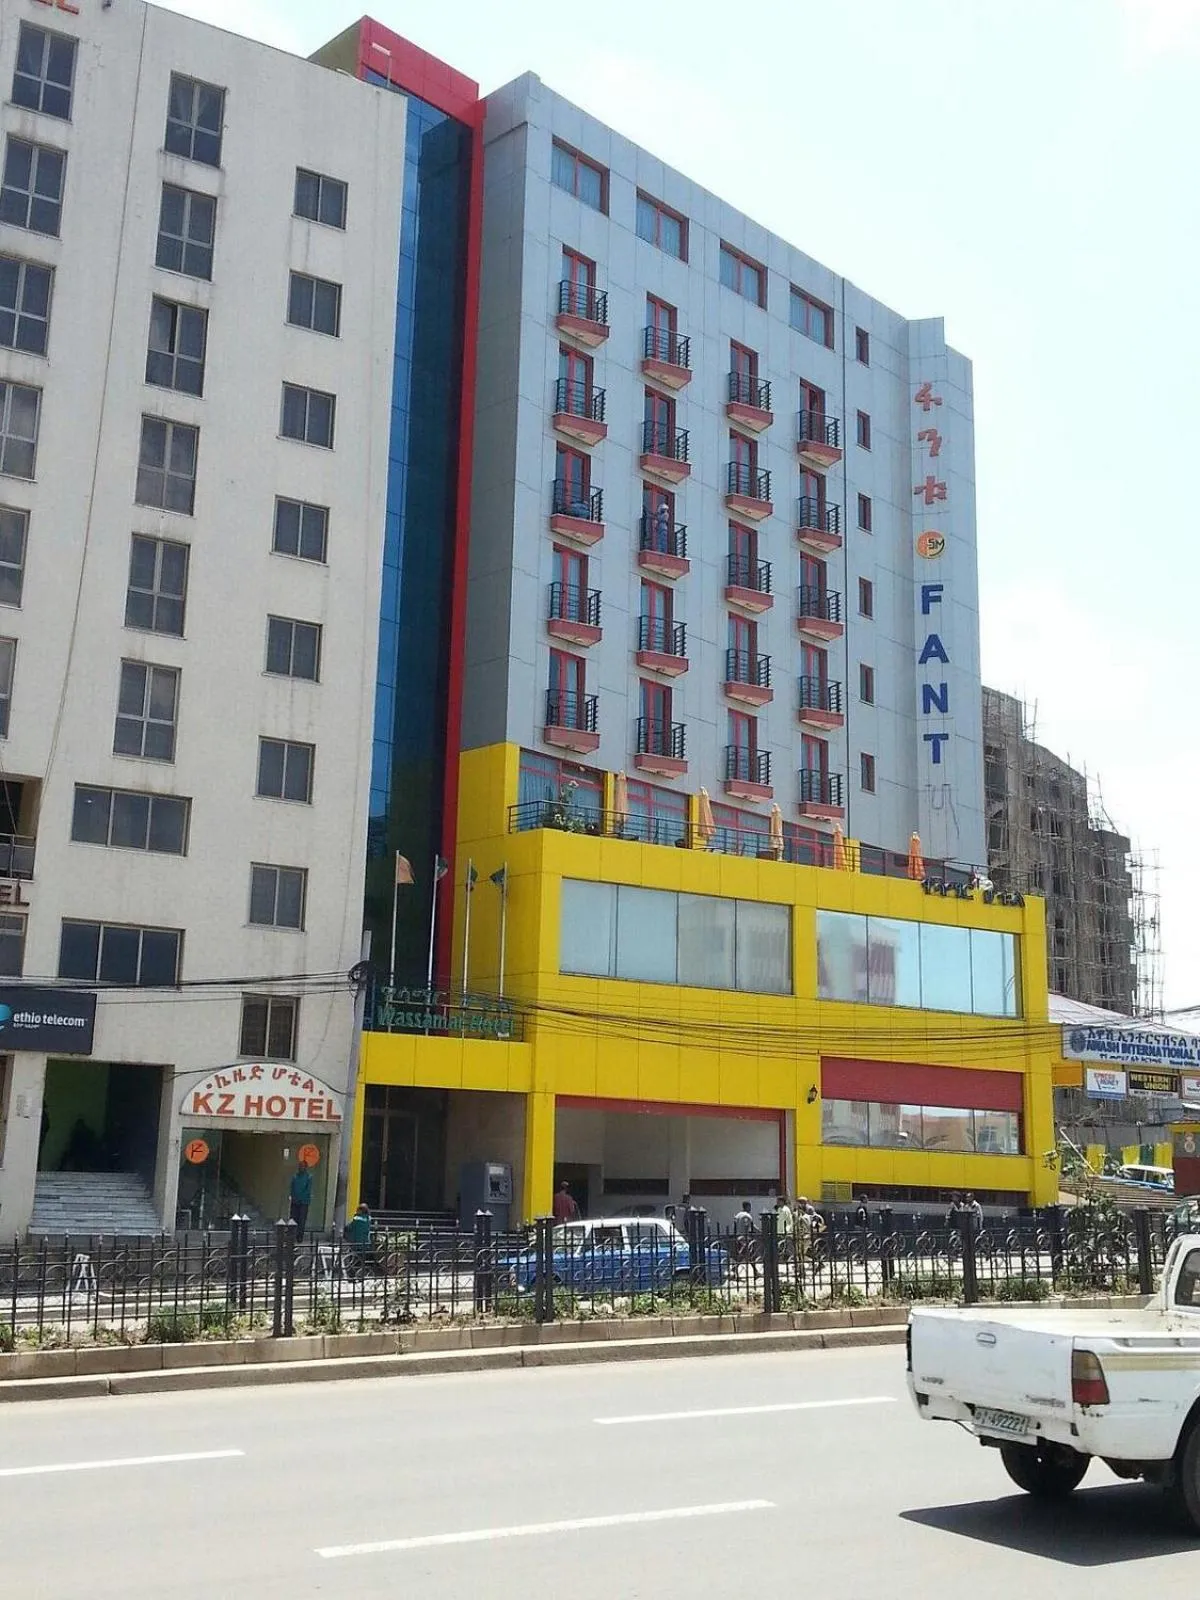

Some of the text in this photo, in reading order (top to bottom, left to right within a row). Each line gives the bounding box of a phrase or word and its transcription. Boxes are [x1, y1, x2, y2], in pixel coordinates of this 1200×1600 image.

[918, 584, 950, 764] FANT
[14, 1012, 85, 1027] ethio telecom
[1087, 1040, 1120, 1054] AWASH
[1121, 1043, 1195, 1060] INTERNATIONAL
[192, 1092, 342, 1120] KZ HOTEL
